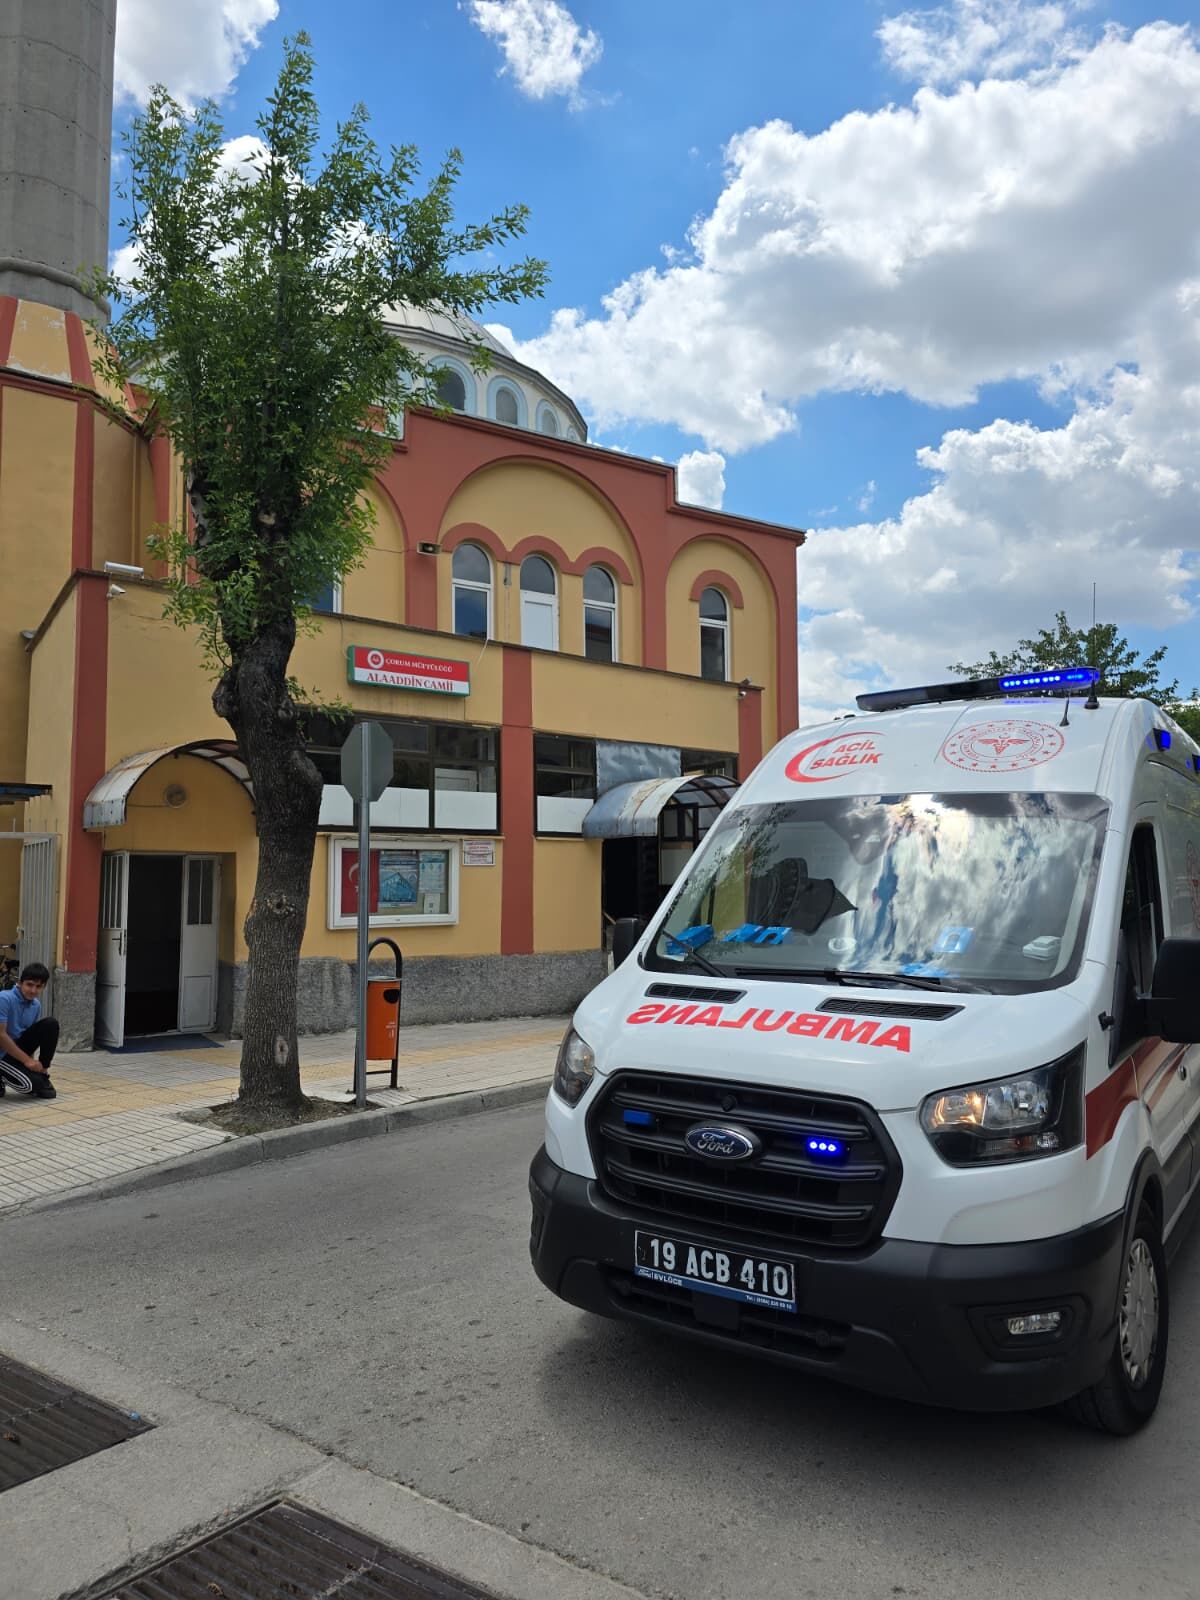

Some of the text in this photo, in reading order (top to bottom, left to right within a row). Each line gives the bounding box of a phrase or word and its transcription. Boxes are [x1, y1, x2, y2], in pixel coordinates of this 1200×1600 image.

[367, 672, 453, 692] ALAADDİN CAMİİ
[832, 739, 876, 754] ACİL
[809, 752, 884, 770] SAĞLIK
[697, 1132, 735, 1154] Ford
[650, 1238, 788, 1296] 19 ACB 410
